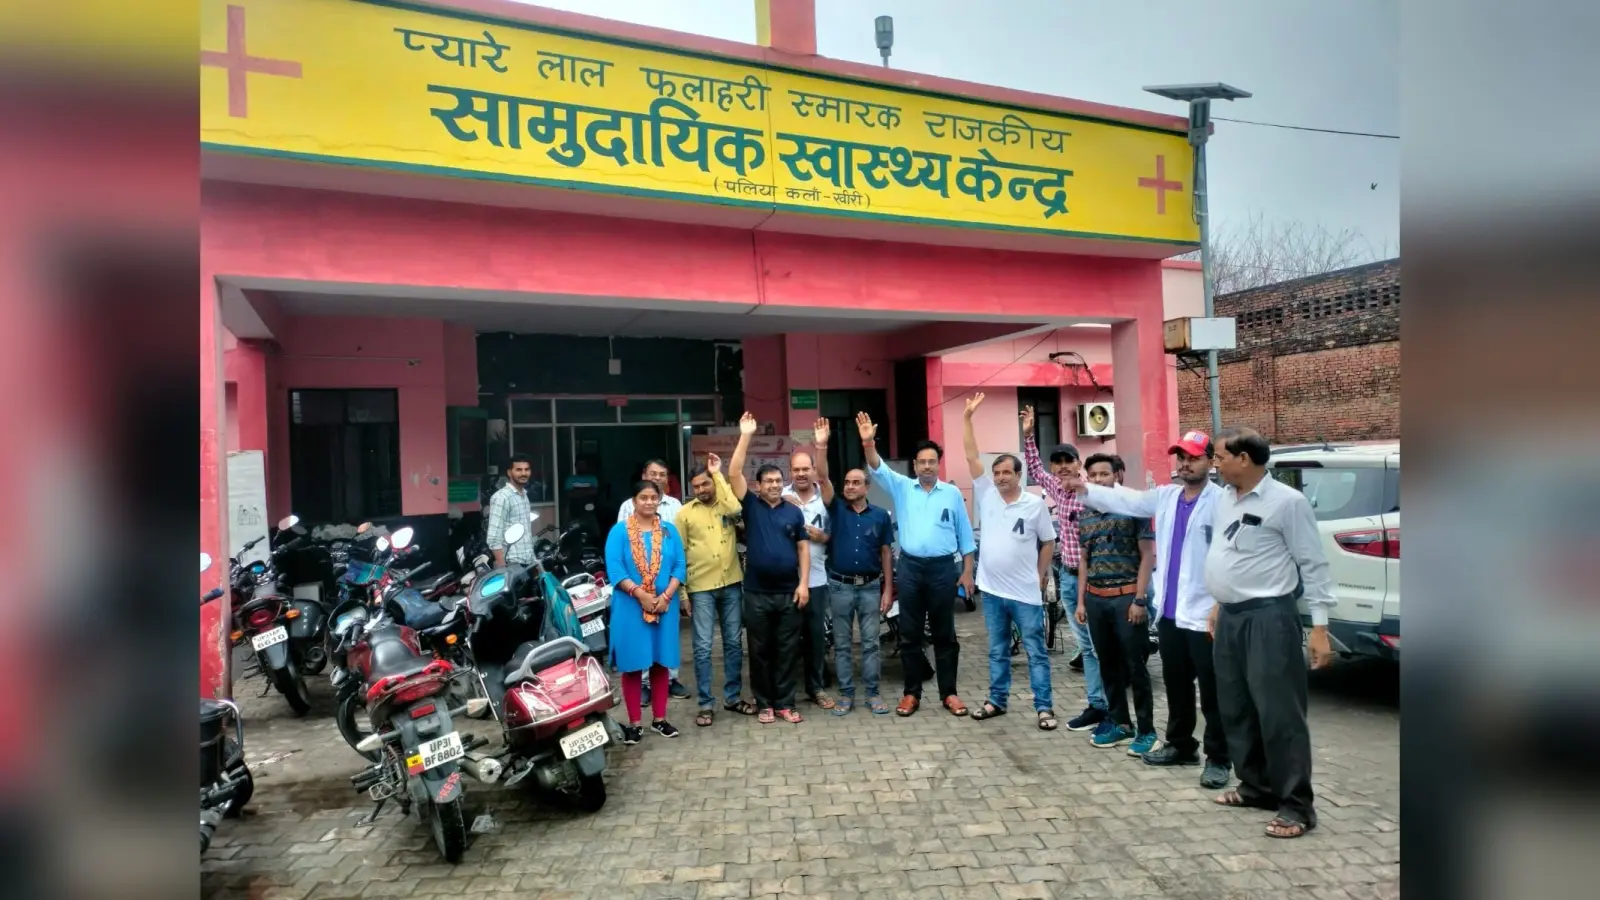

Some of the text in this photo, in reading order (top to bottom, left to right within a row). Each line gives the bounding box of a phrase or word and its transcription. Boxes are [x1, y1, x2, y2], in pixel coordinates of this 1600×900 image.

[393, 30, 1072, 154] प्यारे लाल फलाहरी स्मारक राजकीय
[427, 83, 1074, 219] सामुदायिक स्वास्थ्य केन्द्र
[424, 745, 462, 768] BF8802
[429, 737, 452, 753] UP31
[569, 734, 604, 757] 6819
